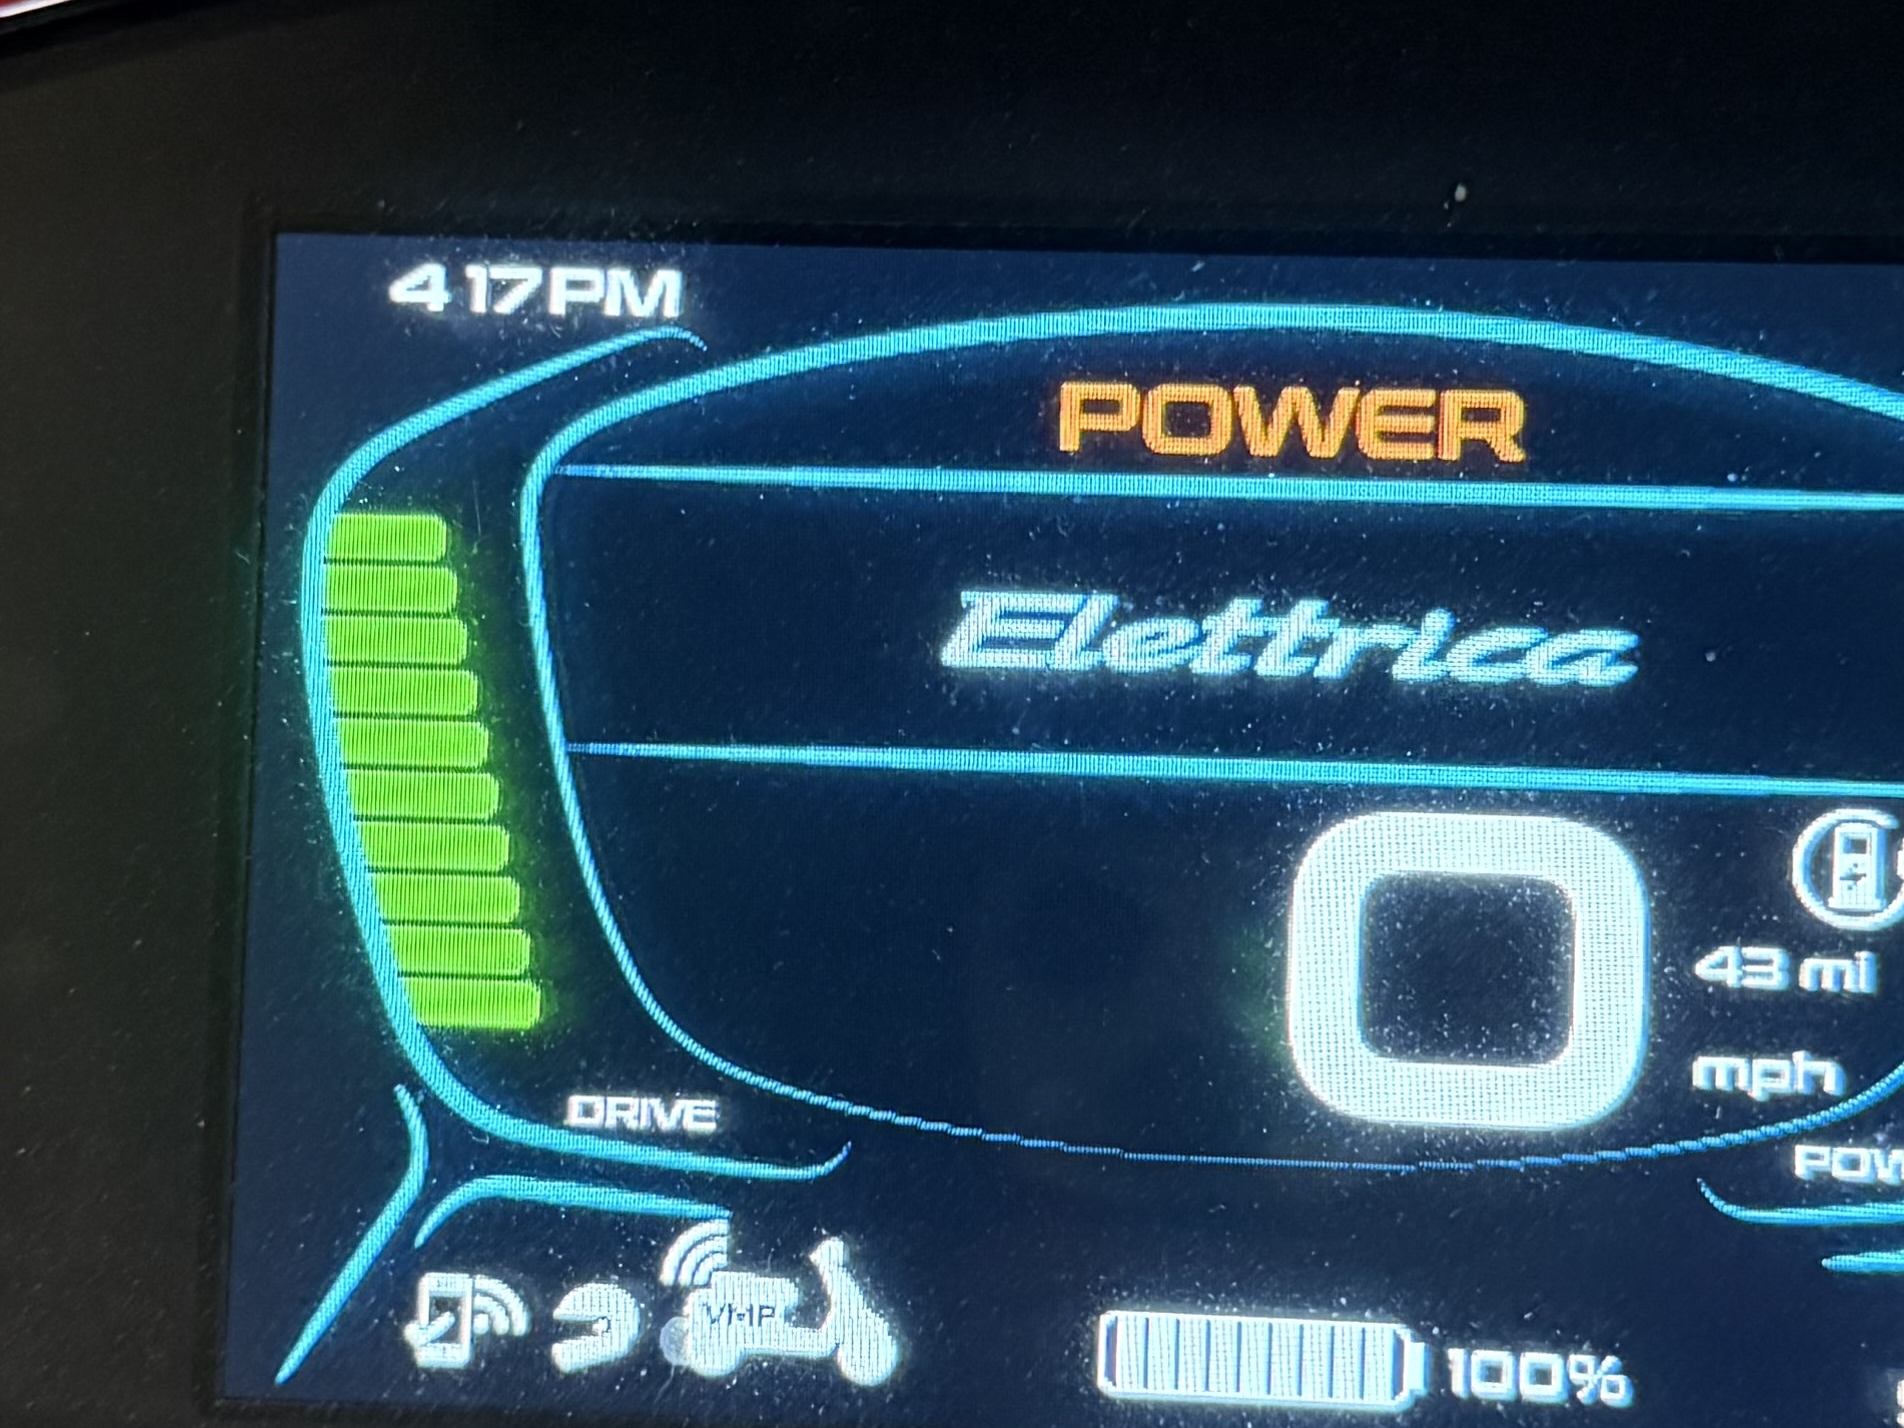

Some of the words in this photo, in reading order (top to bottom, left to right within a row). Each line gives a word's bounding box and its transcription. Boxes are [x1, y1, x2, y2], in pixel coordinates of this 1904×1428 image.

[1058, 379, 1528, 463] POWER
[939, 588, 1641, 688] Elettrica
[1283, 812, 1649, 1132] 0
[1694, 946, 1790, 991] 43
[1799, 950, 1879, 996] mi
[1691, 1050, 1847, 1102] mph
[567, 1093, 721, 1135] DRIVE
[1447, 1346, 1636, 1409] 100%
